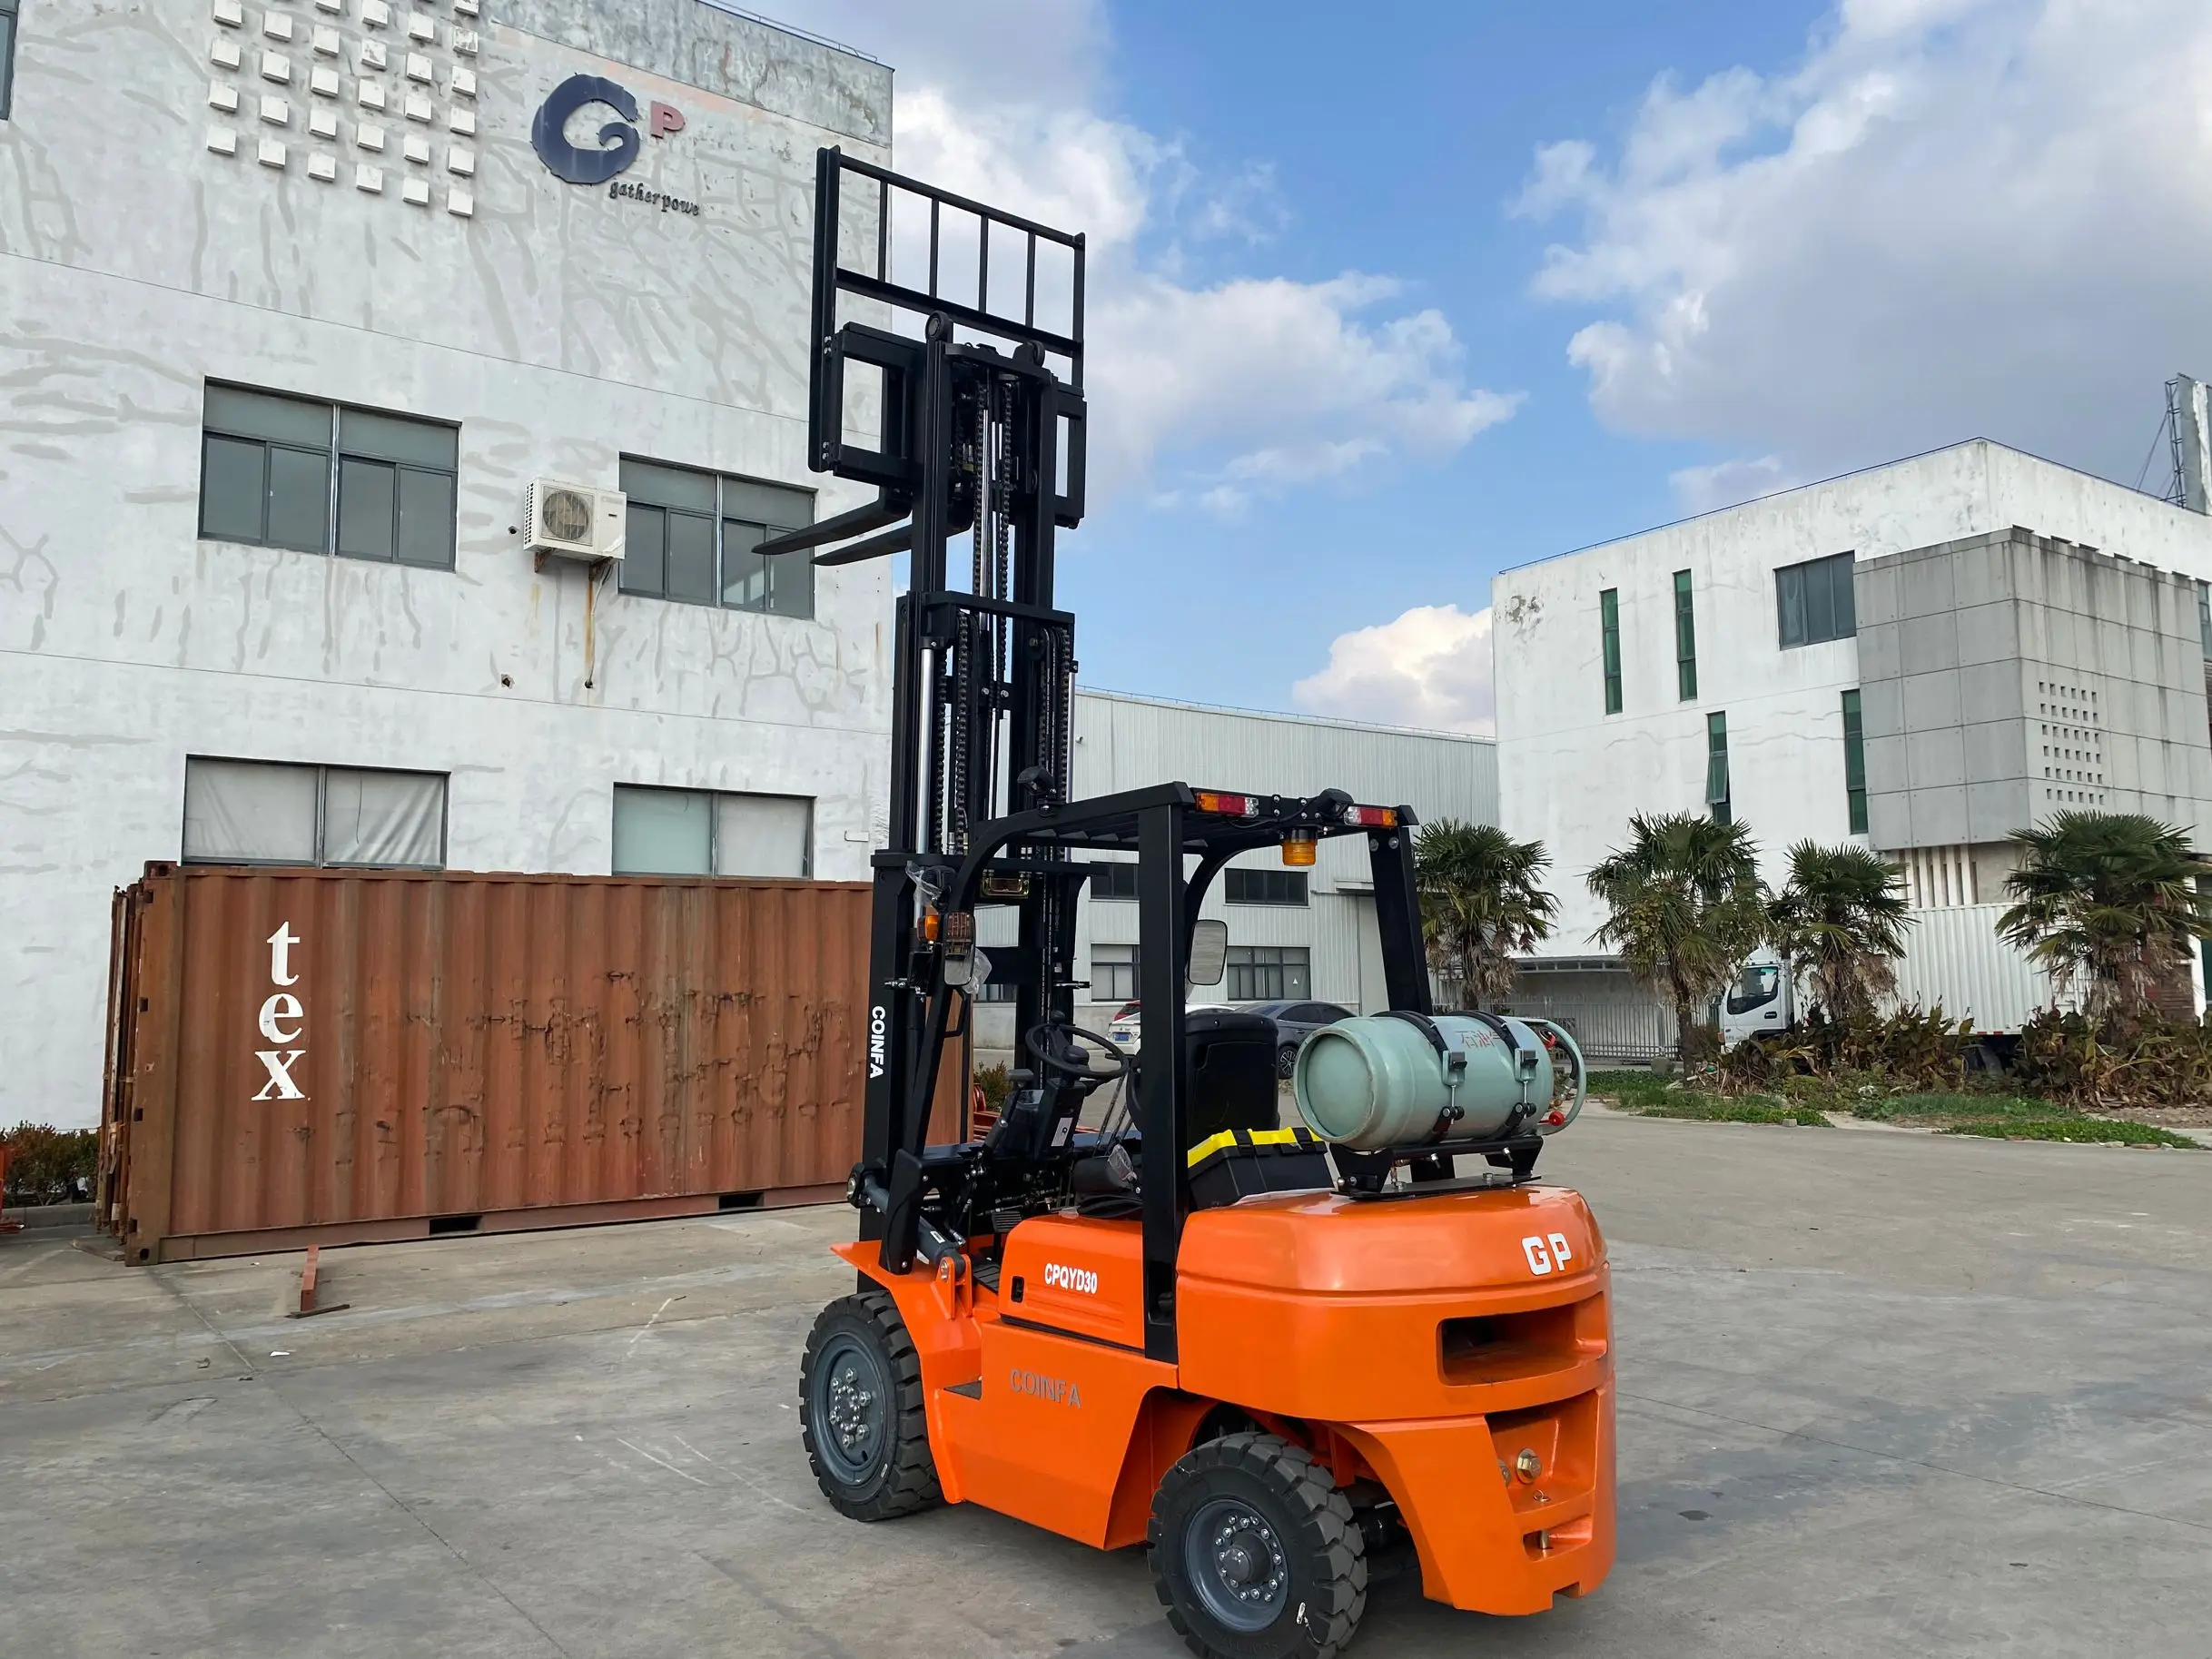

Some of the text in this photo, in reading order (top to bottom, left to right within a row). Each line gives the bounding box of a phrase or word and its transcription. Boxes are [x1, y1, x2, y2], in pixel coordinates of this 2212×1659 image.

[251, 920, 307, 1101] tex
[869, 1005, 886, 1079] COINFA
[1521, 1232, 1573, 1276] GP
[1044, 1262, 1098, 1295] CPQYD30
[1010, 1368, 1082, 1409] COINFA
